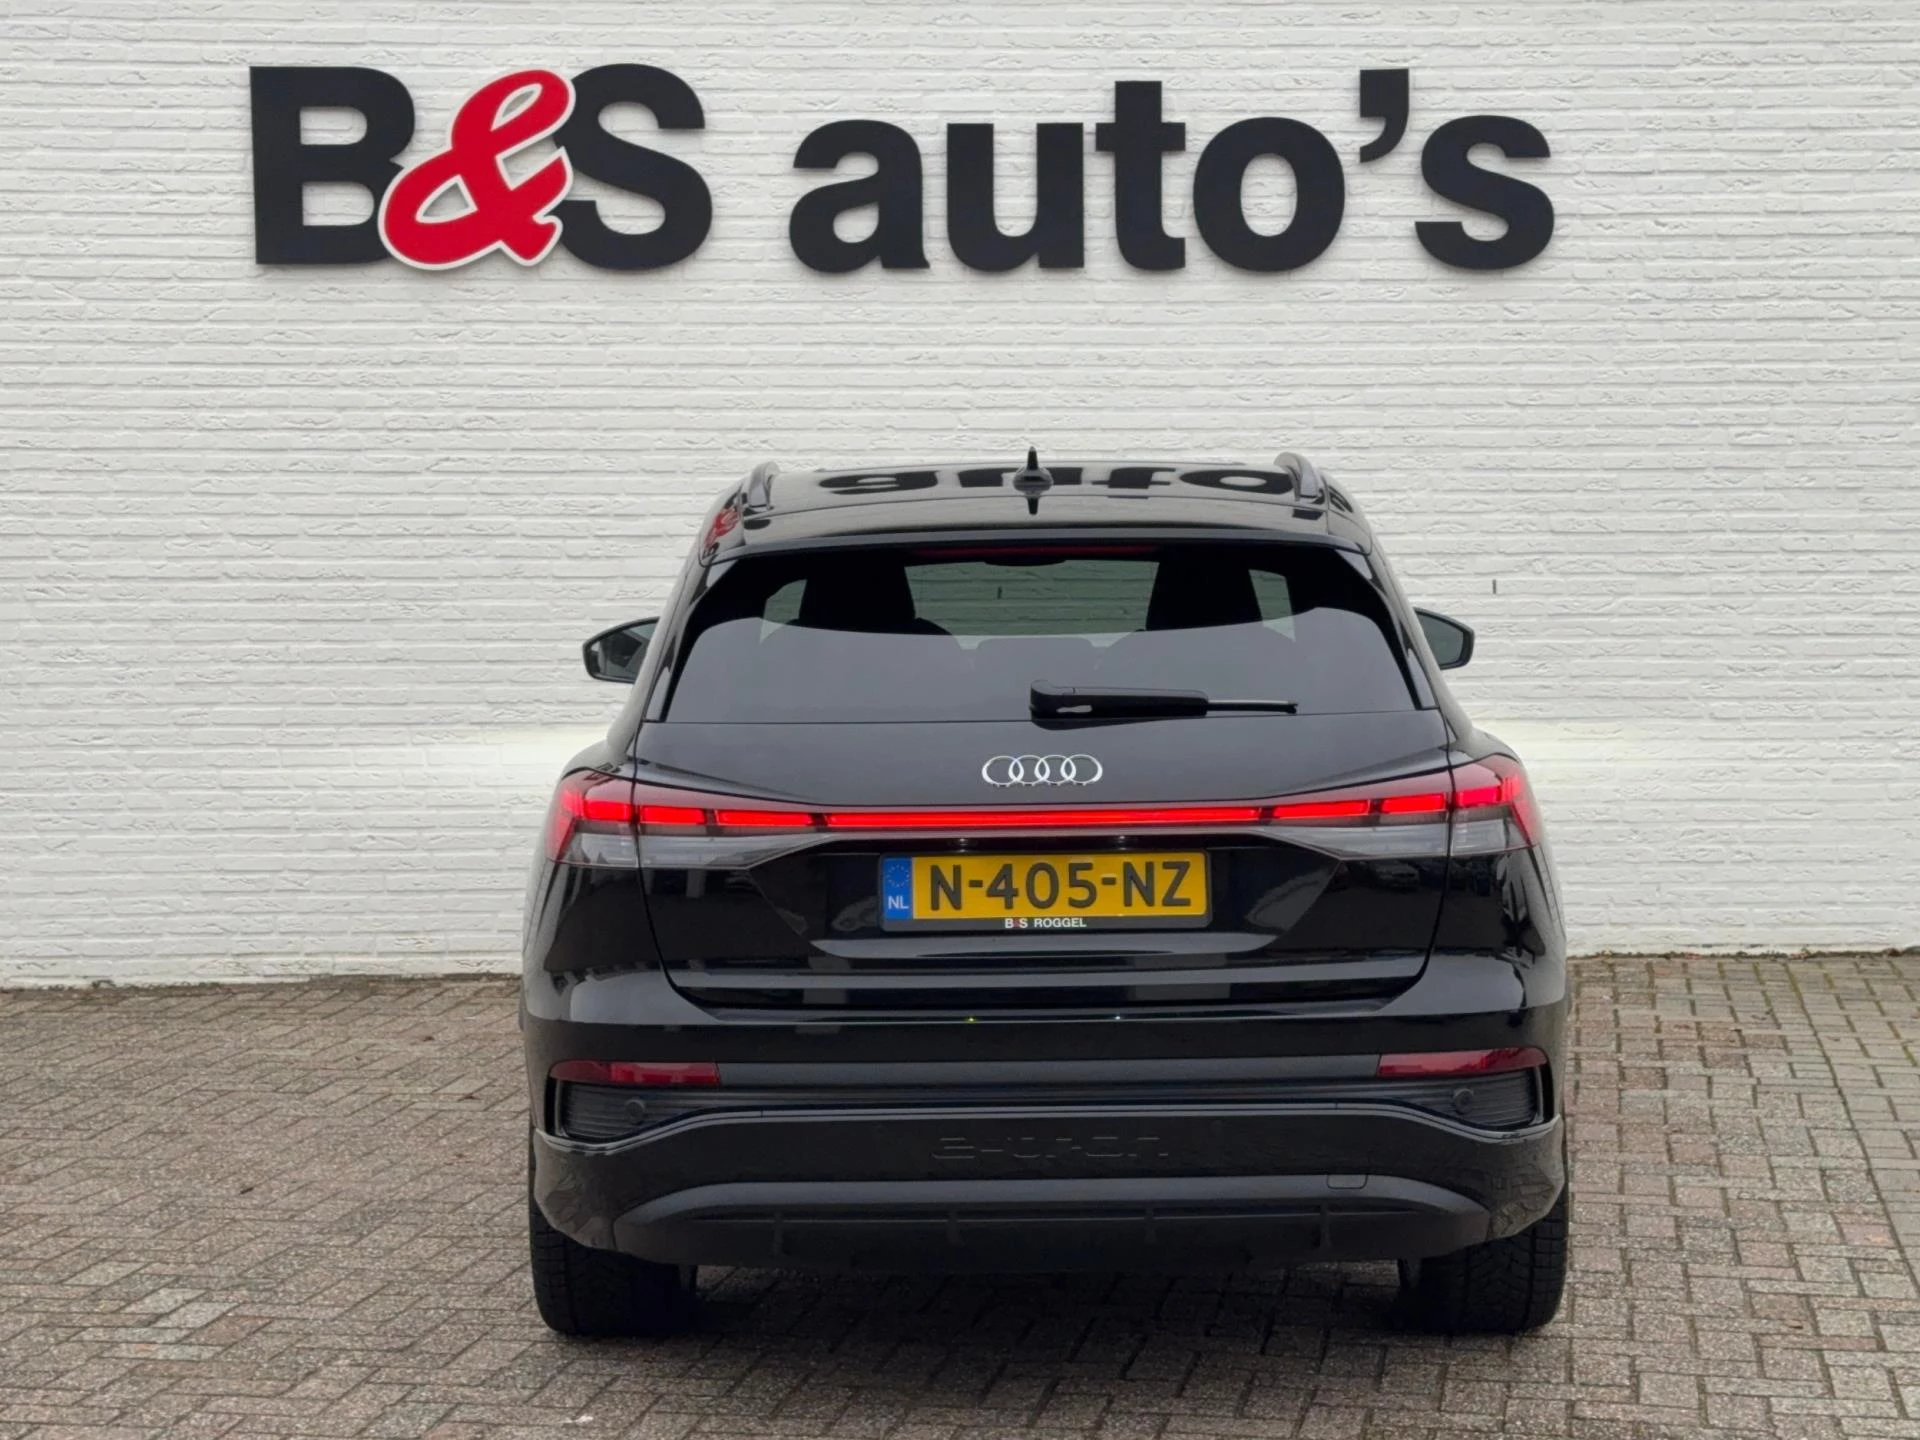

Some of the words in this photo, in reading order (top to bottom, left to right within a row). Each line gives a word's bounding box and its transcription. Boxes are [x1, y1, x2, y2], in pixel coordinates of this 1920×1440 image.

[249, 63, 713, 273] B&S
[789, 68, 1555, 275] auto's
[888, 896, 909, 910] NL
[930, 861, 1192, 911] N-405-NZ
[1004, 917, 1029, 929] BS
[1034, 917, 1087, 928] ROGGEL
